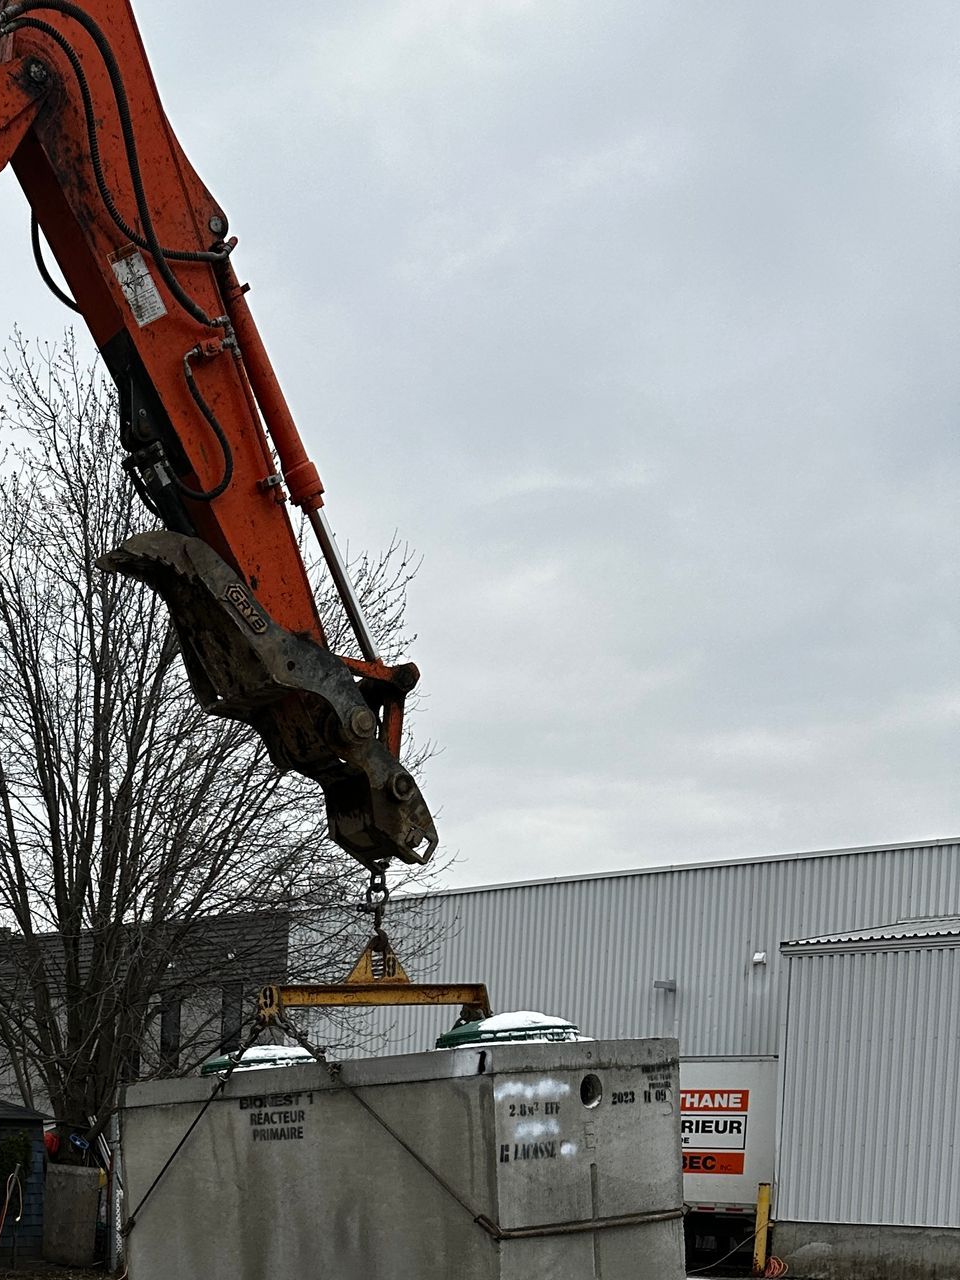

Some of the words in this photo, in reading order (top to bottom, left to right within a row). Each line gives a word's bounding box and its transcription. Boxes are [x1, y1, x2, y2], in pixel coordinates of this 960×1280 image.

[230, 589, 266, 631] GRYB
[611, 1090, 635, 1106] 2023
[249, 1109, 305, 1126] RÉACTEUR
[253, 1126, 304, 1142] PRIMAIRE
[681, 1119, 742, 1135] RIEUR
